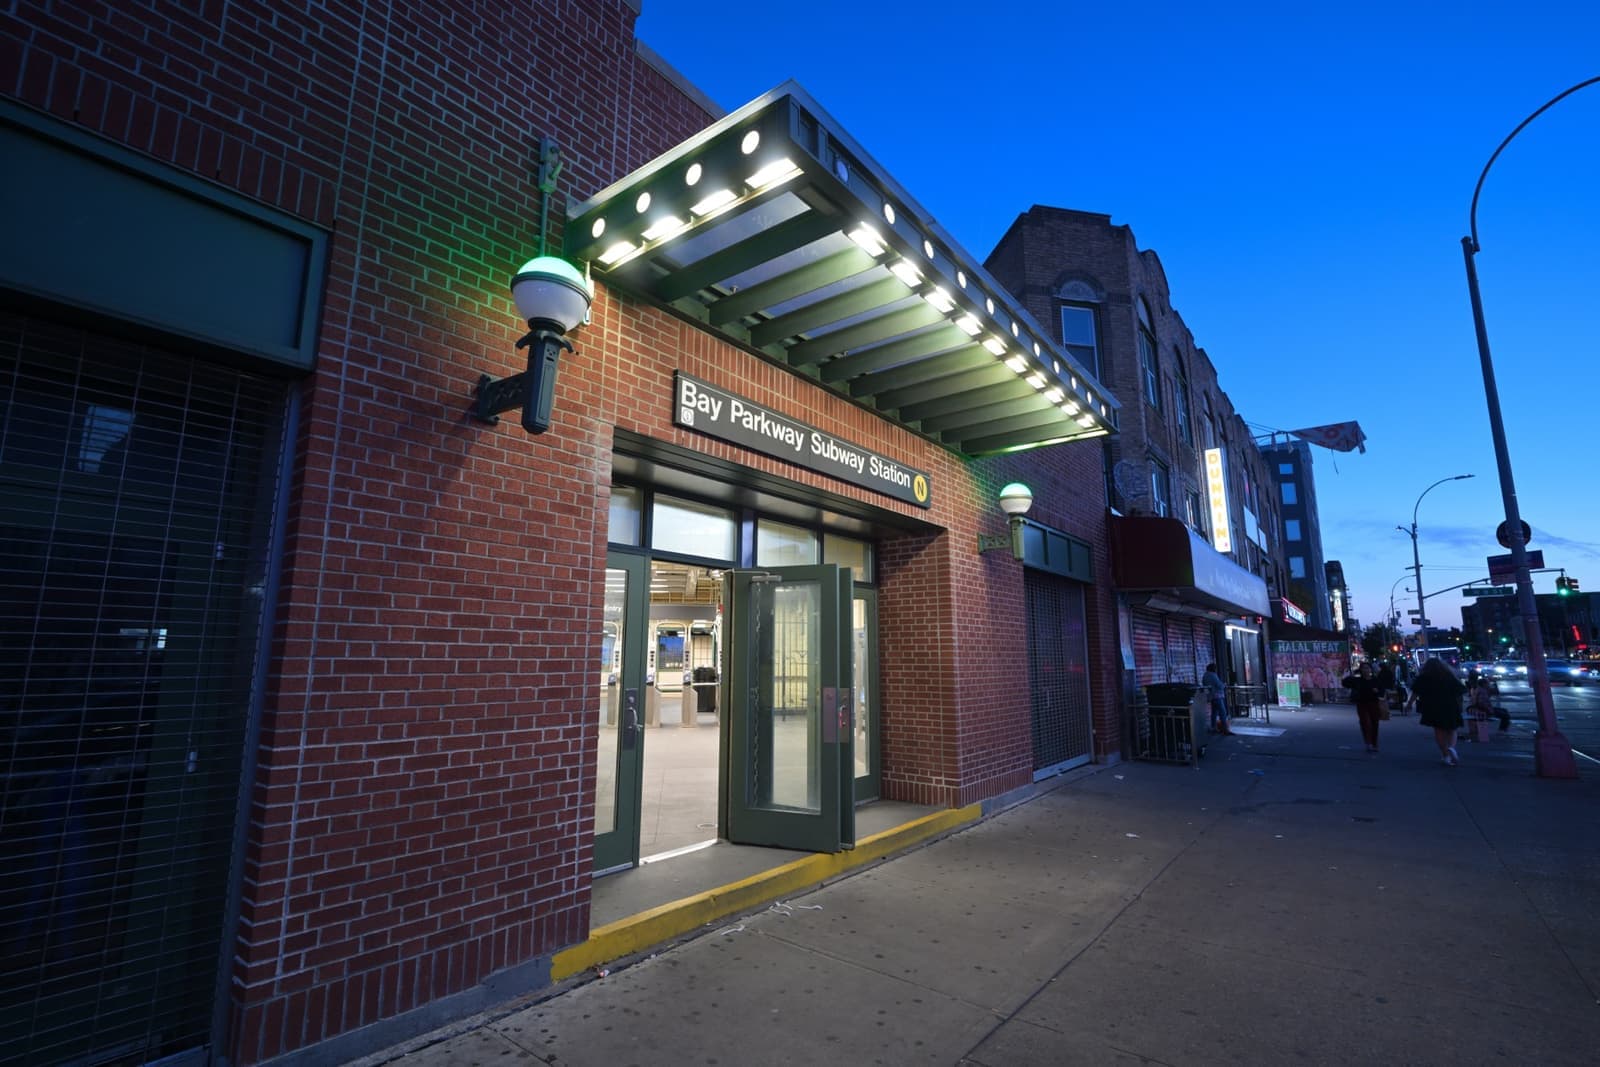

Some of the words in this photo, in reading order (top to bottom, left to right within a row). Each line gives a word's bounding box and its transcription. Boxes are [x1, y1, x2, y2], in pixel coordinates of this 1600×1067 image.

[681, 379, 722, 421] Bay
[730, 399, 805, 452] Parkway
[810, 432, 865, 474] Subway
[869, 455, 910, 489] Station
[1278, 642, 1310, 652] HALAL
[1312, 642, 1339, 652] MEAT
